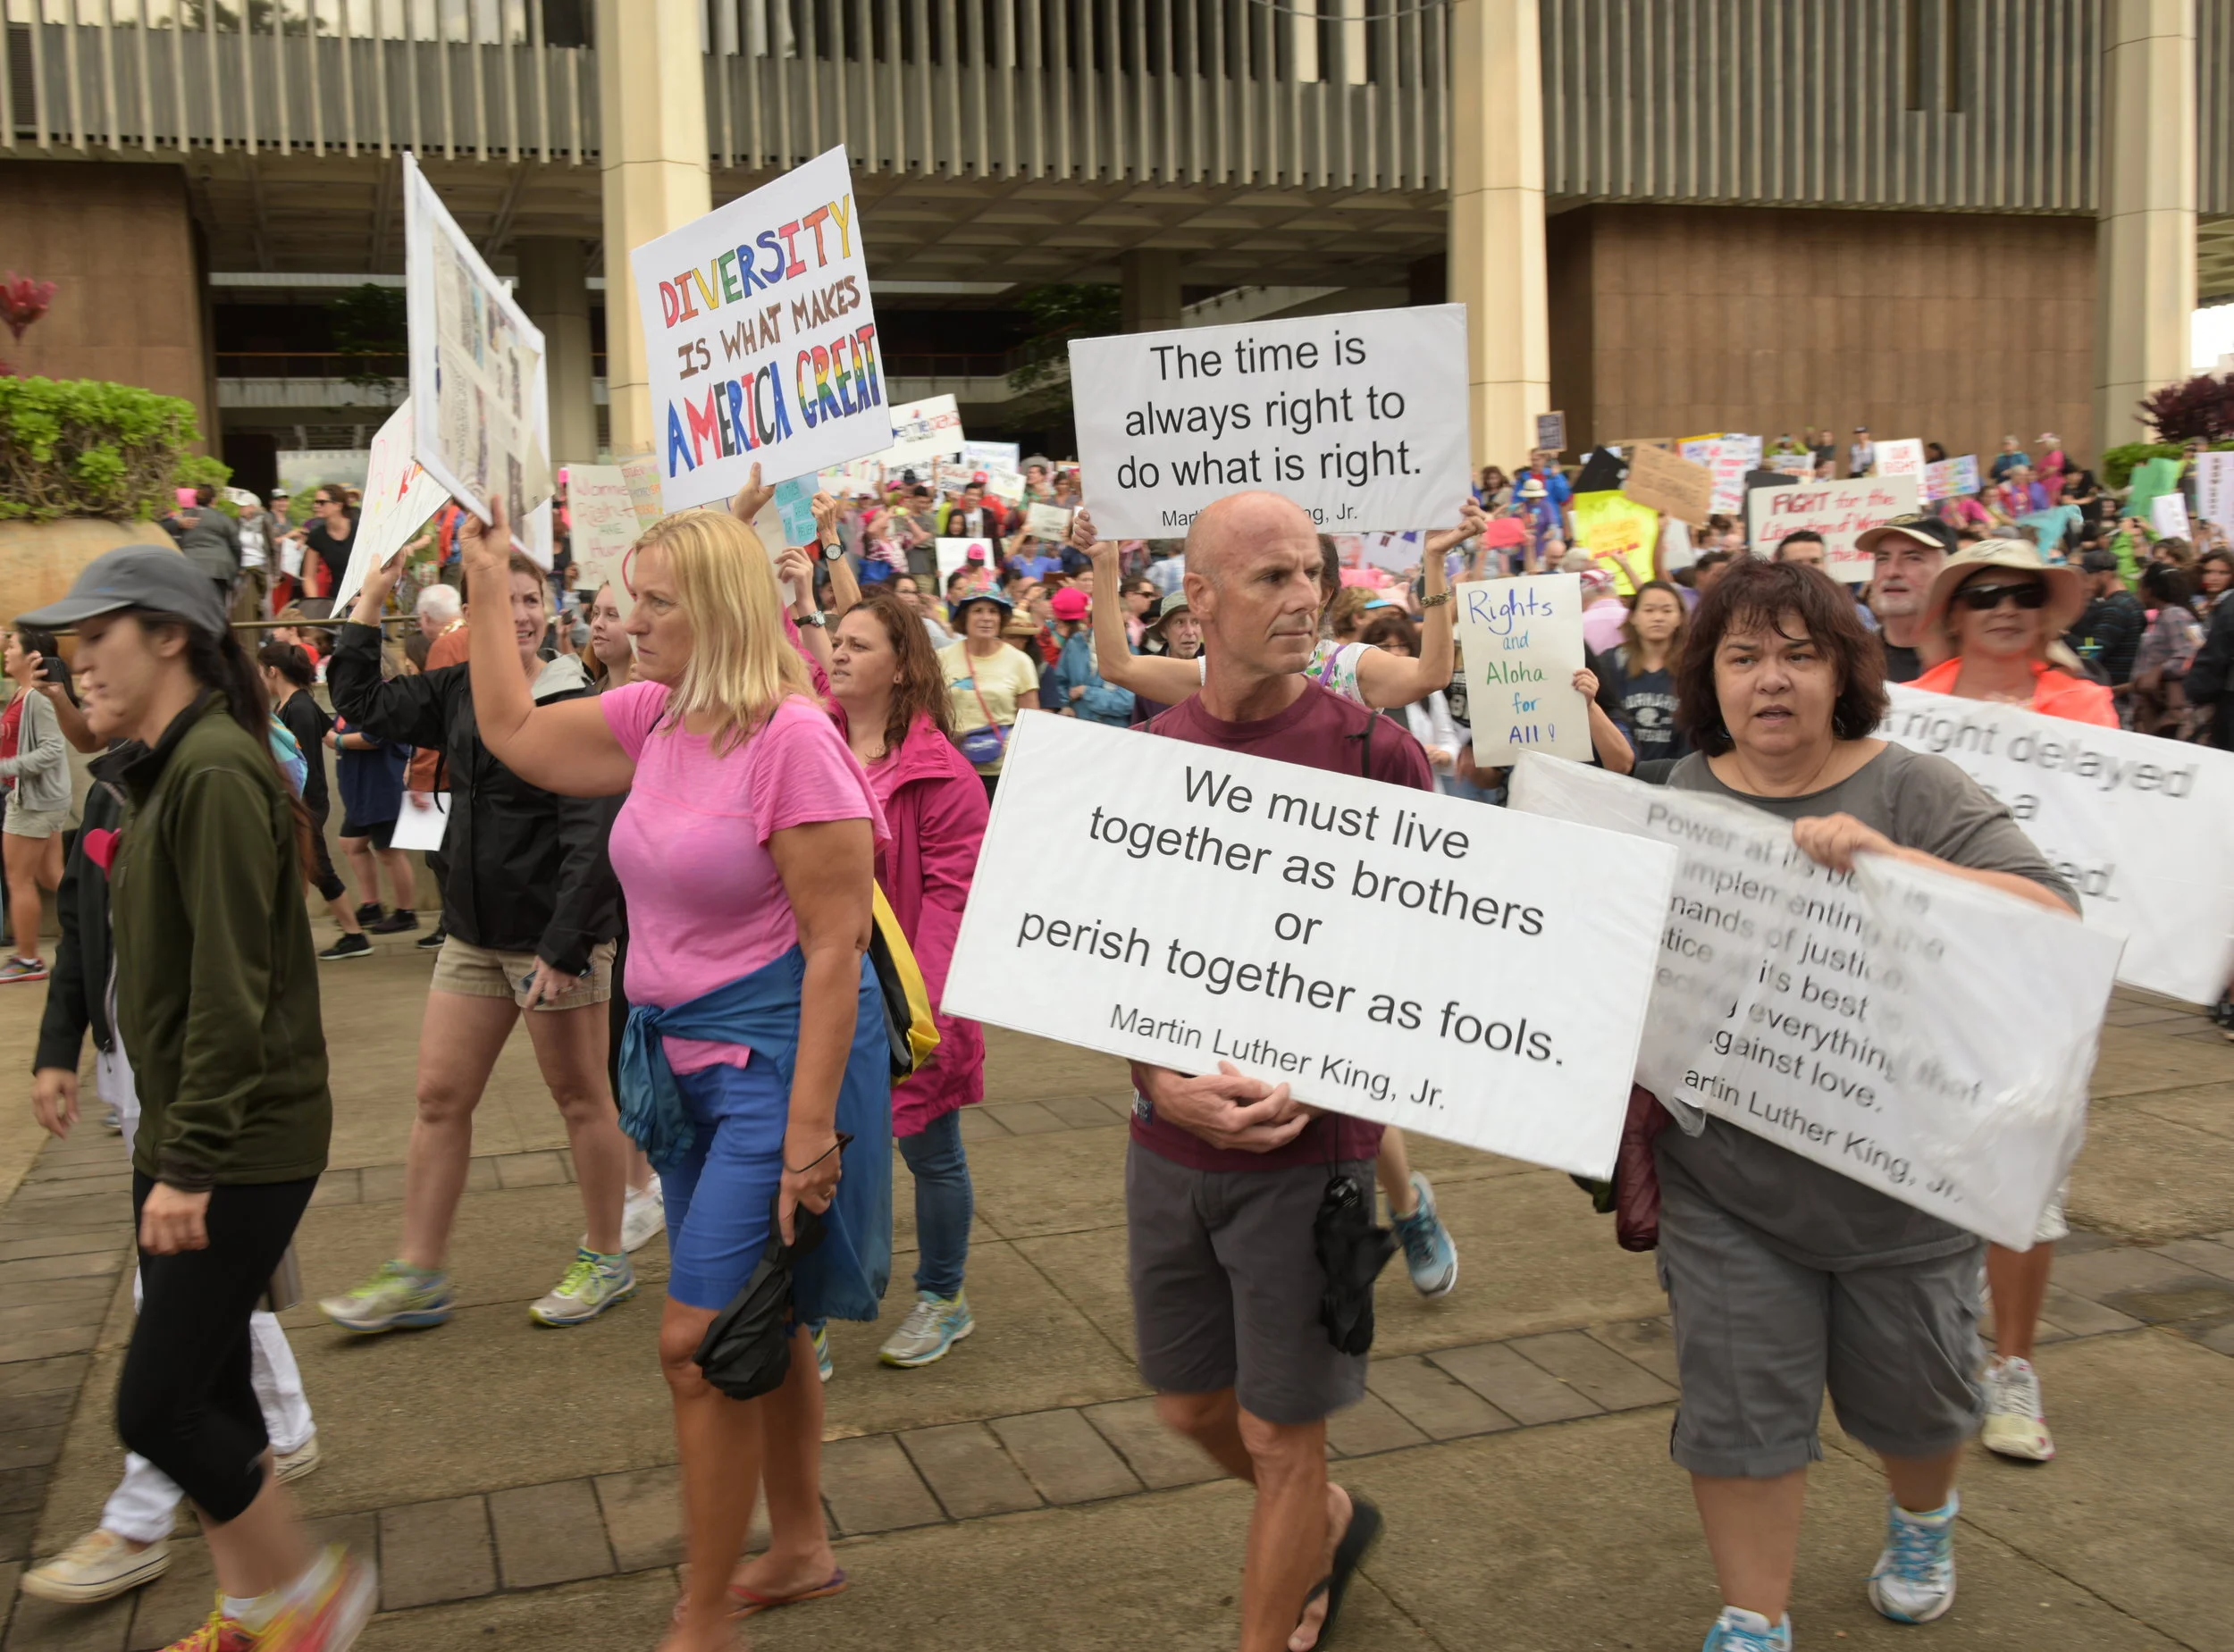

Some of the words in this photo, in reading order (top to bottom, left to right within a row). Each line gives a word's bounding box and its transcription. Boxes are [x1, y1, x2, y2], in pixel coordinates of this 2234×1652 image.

[659, 193, 851, 328] DIVERSITY
[677, 338, 711, 380] IS
[719, 302, 781, 363] WHAT
[792, 275, 861, 334] MAKES
[1150, 345, 1222, 381] The
[1235, 338, 1318, 373] time
[1335, 331, 1366, 365] is
[668, 360, 793, 478] AMERICA
[796, 323, 880, 428] GREAT
[1125, 401, 1251, 440] always
[1265, 387, 1354, 434] right
[1366, 386, 1405, 420] to
[1118, 456, 1159, 489] do
[1172, 449, 1262, 486] what
[1275, 447, 1304, 481] is
[1320, 440, 1421, 487] right.
[1336, 503, 1358, 520] Jr.
[1770, 491, 1833, 516] FIGHT
[1834, 491, 1861, 509] for
[1866, 487, 1897, 508] the
[1468, 587, 1553, 635] Rights
[1503, 630, 1529, 651] and
[1486, 660, 1547, 685] Aloha
[1512, 692, 1541, 715] for
[1902, 707, 2000, 753] right
[2007, 727, 2201, 800] delayed
[1186, 766, 1253, 813] We
[1268, 793, 1379, 841] must
[1392, 809, 1469, 860] live
[1646, 802, 1741, 854] Power
[1090, 807, 1272, 874] together
[1283, 855, 1335, 890] as
[1352, 860, 1544, 936] brothers
[1275, 912, 1323, 945] or
[1764, 925, 1796, 953] of
[1017, 912, 1149, 967] perish
[1167, 938, 1356, 1013] together
[1368, 994, 1422, 1030] as
[1440, 1001, 1564, 1067] fools.
[1758, 959, 1793, 994] its
[1800, 975, 1871, 1024] best
[1111, 1004, 1201, 1049] Martin
[1213, 1028, 1312, 1076] Luther
[1321, 1054, 1398, 1103] King,
[1411, 1078, 1447, 1111] Jr.
[1709, 1028, 1805, 1081] gainst
[1810, 1061, 1884, 1114] love.
[1748, 1001, 1896, 1084] everything
[1680, 1069, 1740, 1108] artin
[1748, 1090, 1839, 1147] Luther
[1843, 1130, 1918, 1187] King,
